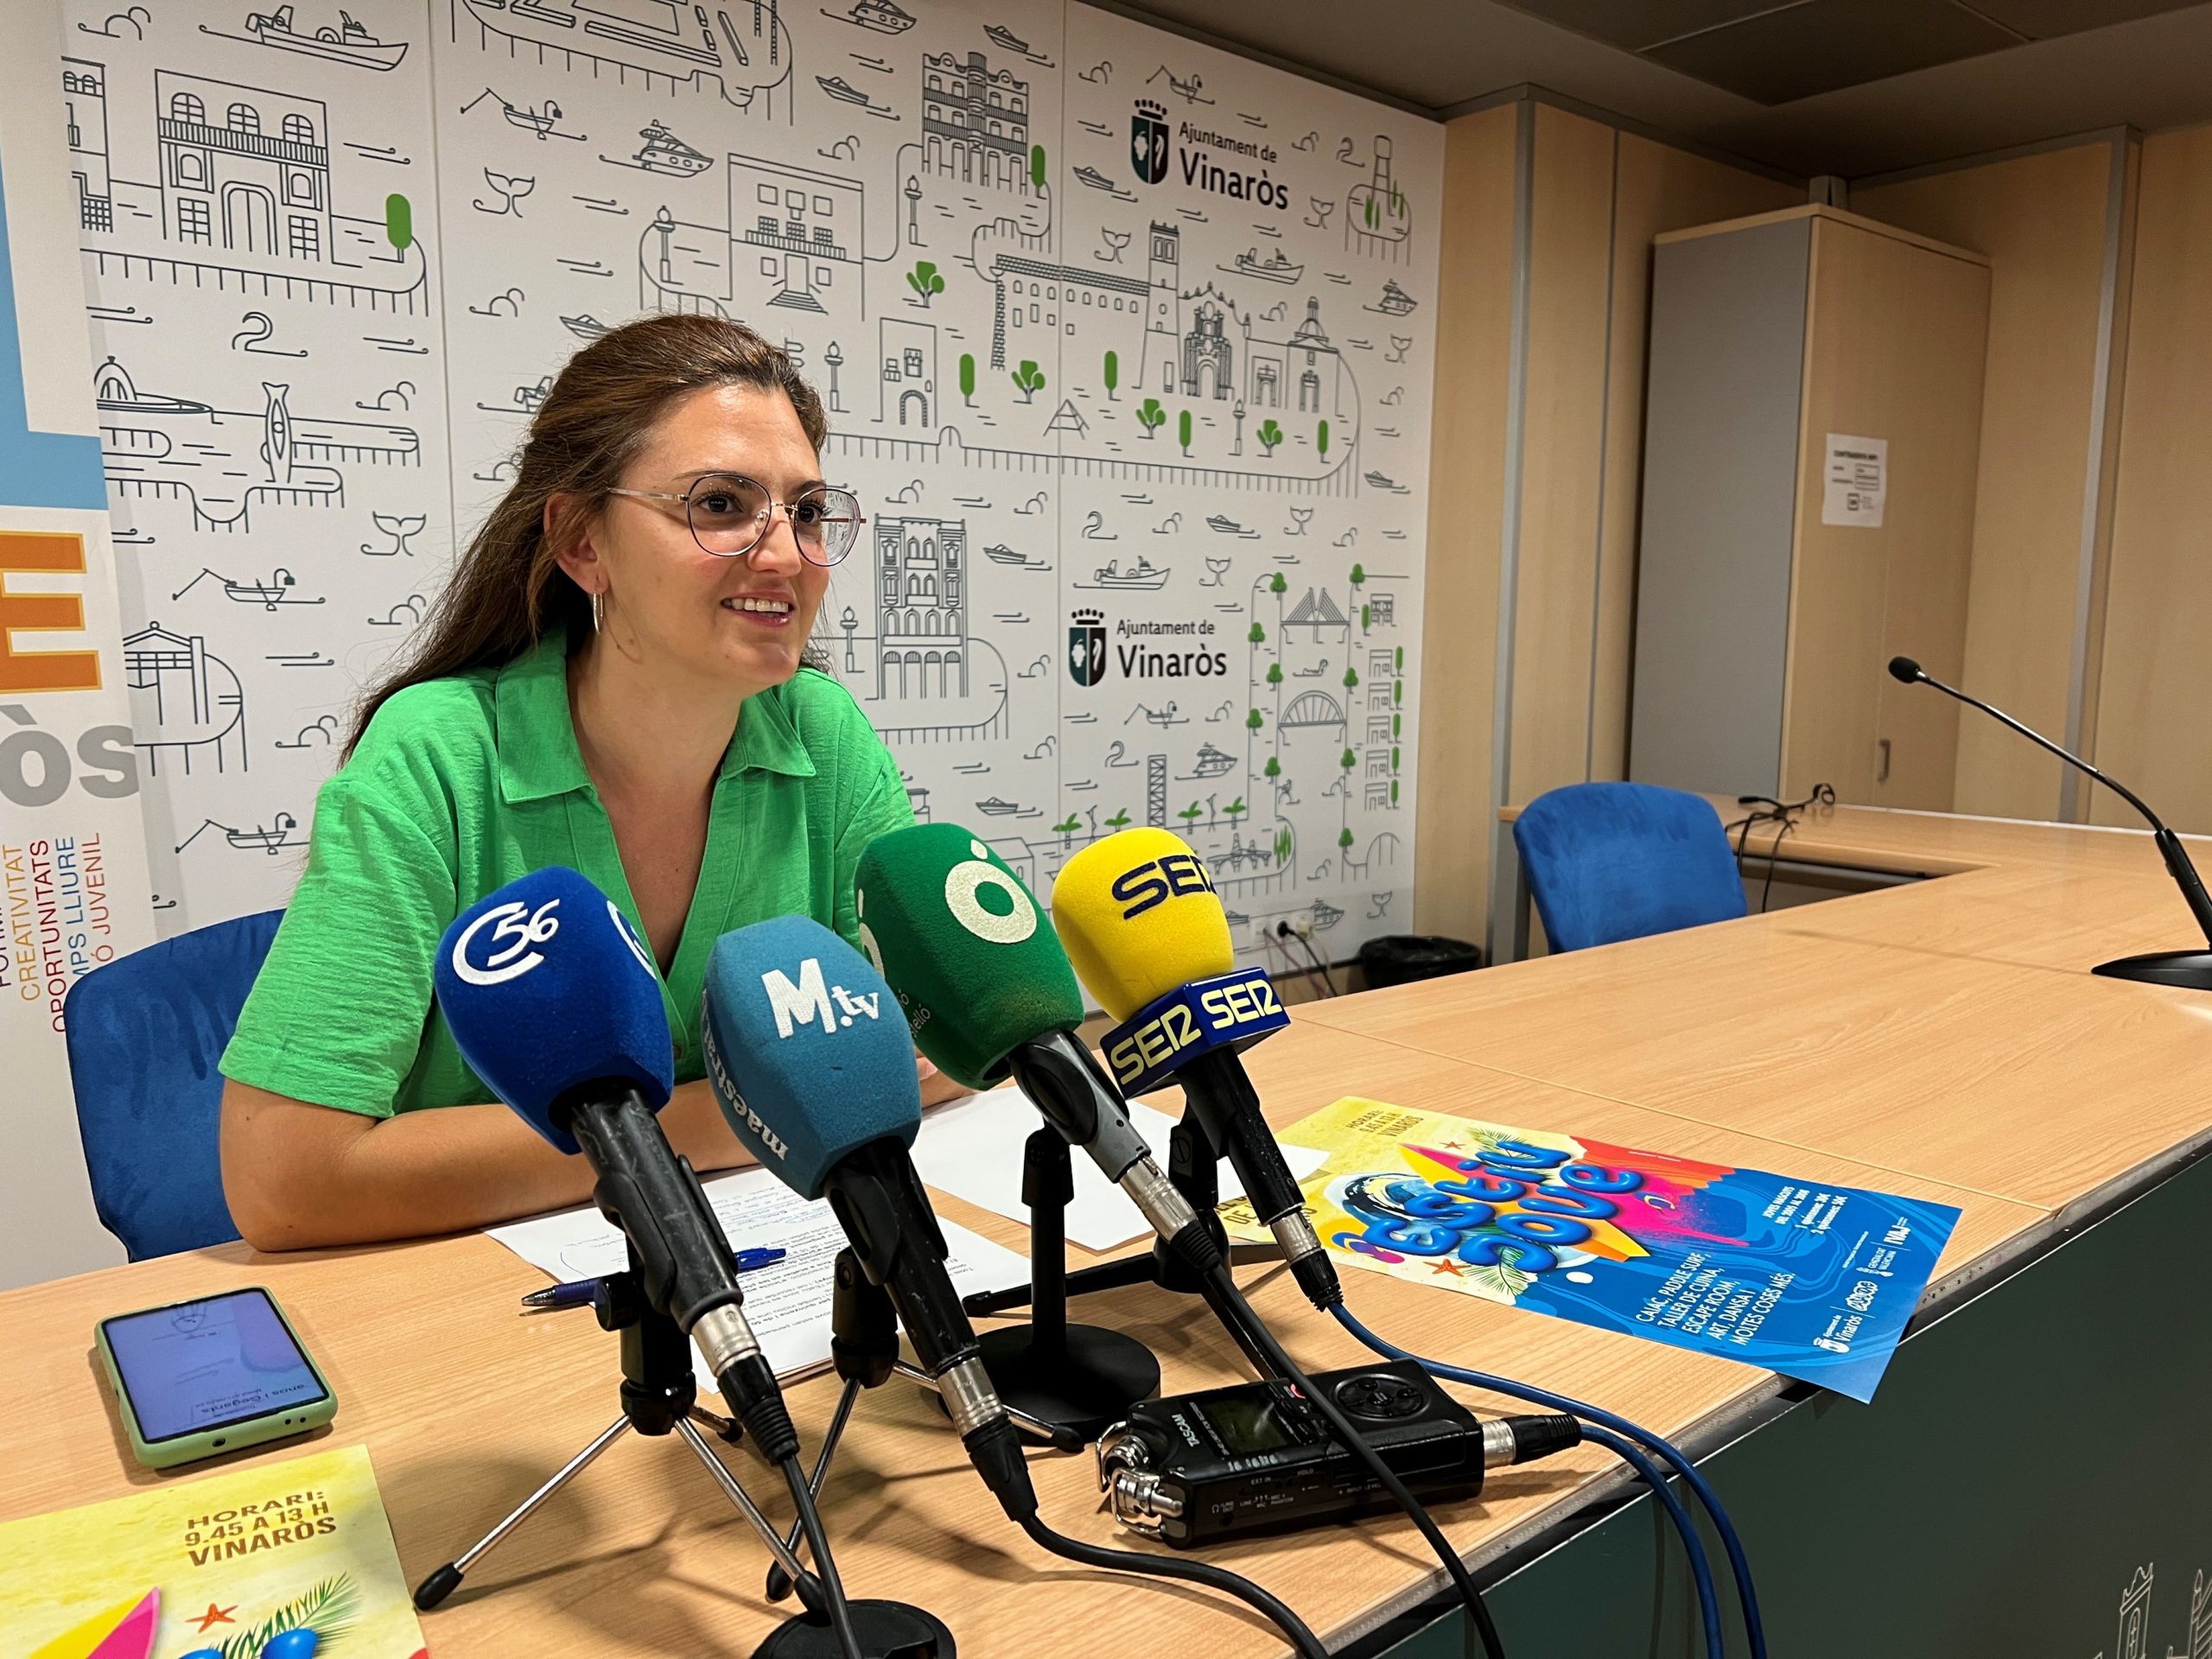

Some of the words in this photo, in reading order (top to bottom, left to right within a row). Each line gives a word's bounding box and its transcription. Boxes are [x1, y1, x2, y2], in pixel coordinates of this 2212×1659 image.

[1179, 121, 1258, 158] Ajuntament
[1260, 144, 1278, 163] de
[1179, 147, 1288, 210] Vinaròs
[1116, 619, 1196, 639] Ajuntament
[1198, 620, 1215, 635] de
[1117, 643, 1227, 678] Vinaròs
[55, 836, 84, 925] LLIURE
[81, 832, 111, 935] JUVENIL
[2, 844, 41, 1001] CREATIVITAT
[29, 839, 67, 1033] OPORTUNITATS
[1636, 1297, 1671, 1322] CAIAC,
[1658, 1271, 1692, 1299] PADDLE
[1685, 1252, 1712, 1272] SURF,
[1679, 1291, 1700, 1306] DE
[1688, 1268, 1725, 1293] CUINA,
[1657, 1305, 1689, 1328] TALLER
[1681, 1305, 1713, 1334] ESCAPE
[1707, 1280, 1741, 1308] ROOM,
[1719, 1298, 1751, 1323] DANSA
[1729, 1313, 1764, 1346] MOLTES
[1751, 1289, 1783, 1314] COSES
[1770, 1272, 1796, 1290] MÉS.
[1706, 1322, 1734, 1340] ART,
[1834, 1315, 1863, 1342] Vinaròs
[1171, 1414, 1200, 1447] TASCAM
[184, 1523, 244, 1548] 9.45
[252, 1516, 270, 1532] A
[276, 1508, 303, 1524] 13
[312, 1501, 329, 1516] H
[187, 1490, 325, 1529] HORARI:
[186, 1516, 337, 1567] VINARÒS
